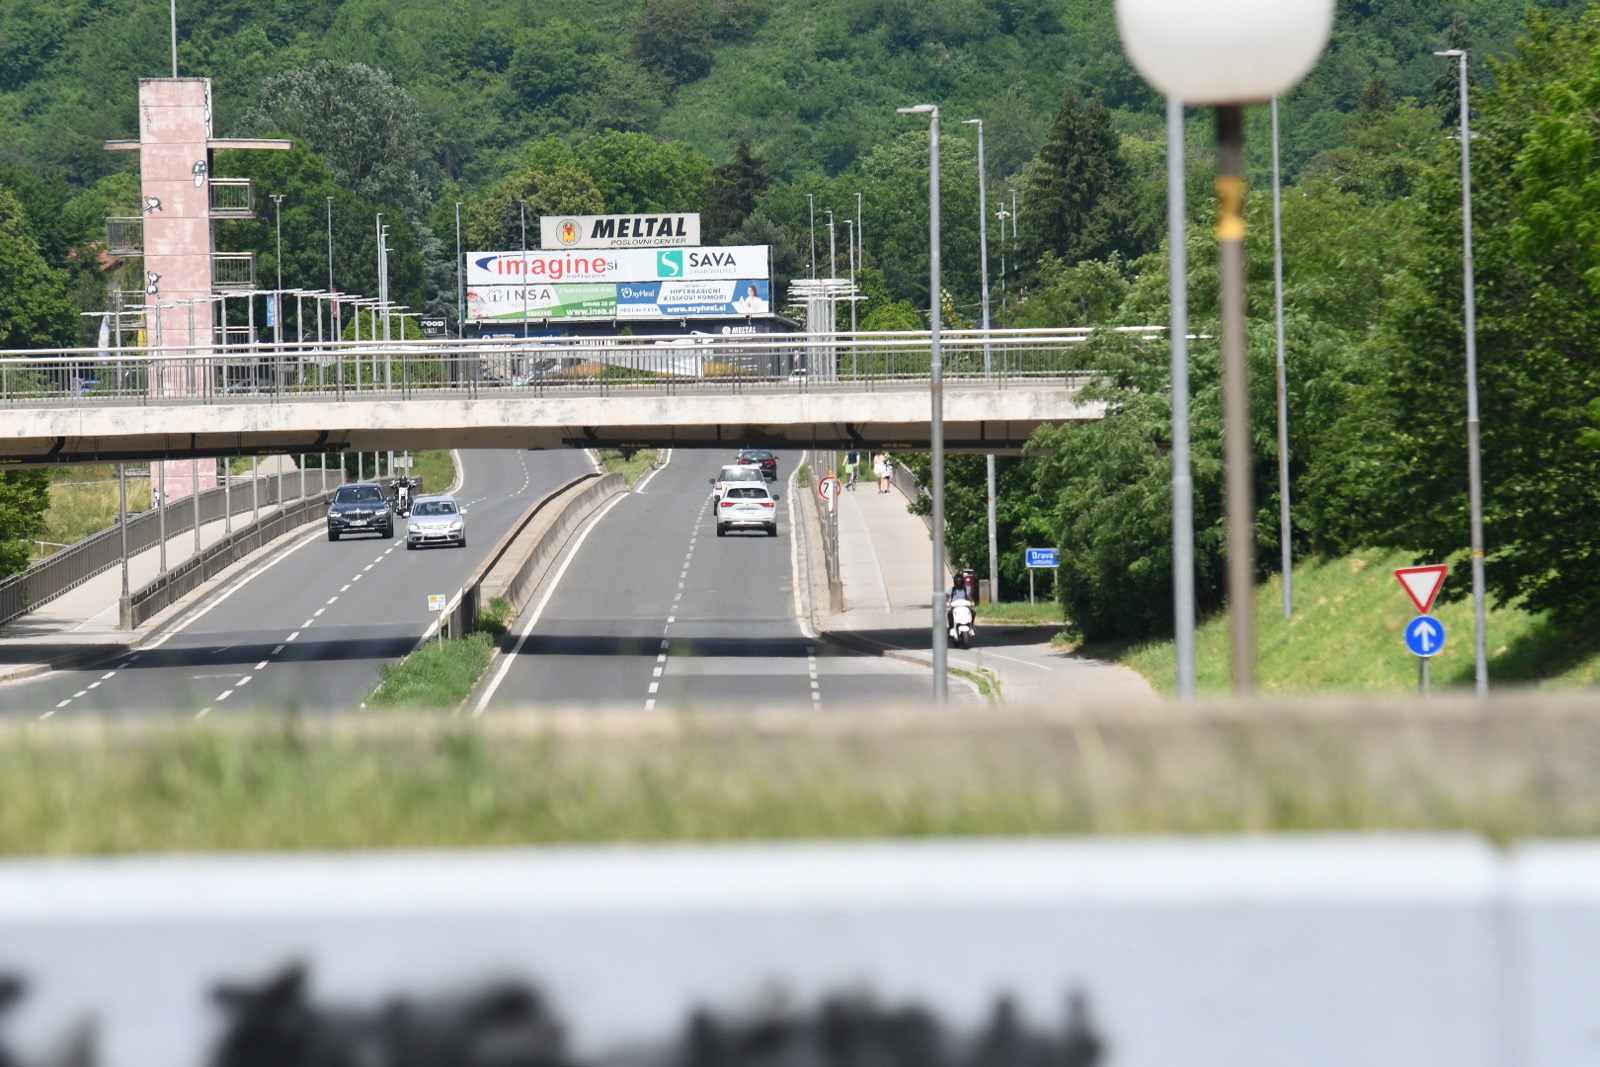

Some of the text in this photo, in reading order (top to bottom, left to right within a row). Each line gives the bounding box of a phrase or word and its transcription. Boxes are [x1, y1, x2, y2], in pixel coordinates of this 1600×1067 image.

[591, 218, 687, 238] MELTAL
[498, 254, 606, 279] imagine
[689, 252, 737, 268] SAVA
[506, 288, 551, 301] INSA
[566, 306, 616, 315] www.insa.si
[731, 326, 757, 334] MELTAL
[1031, 551, 1054, 560] Drava
